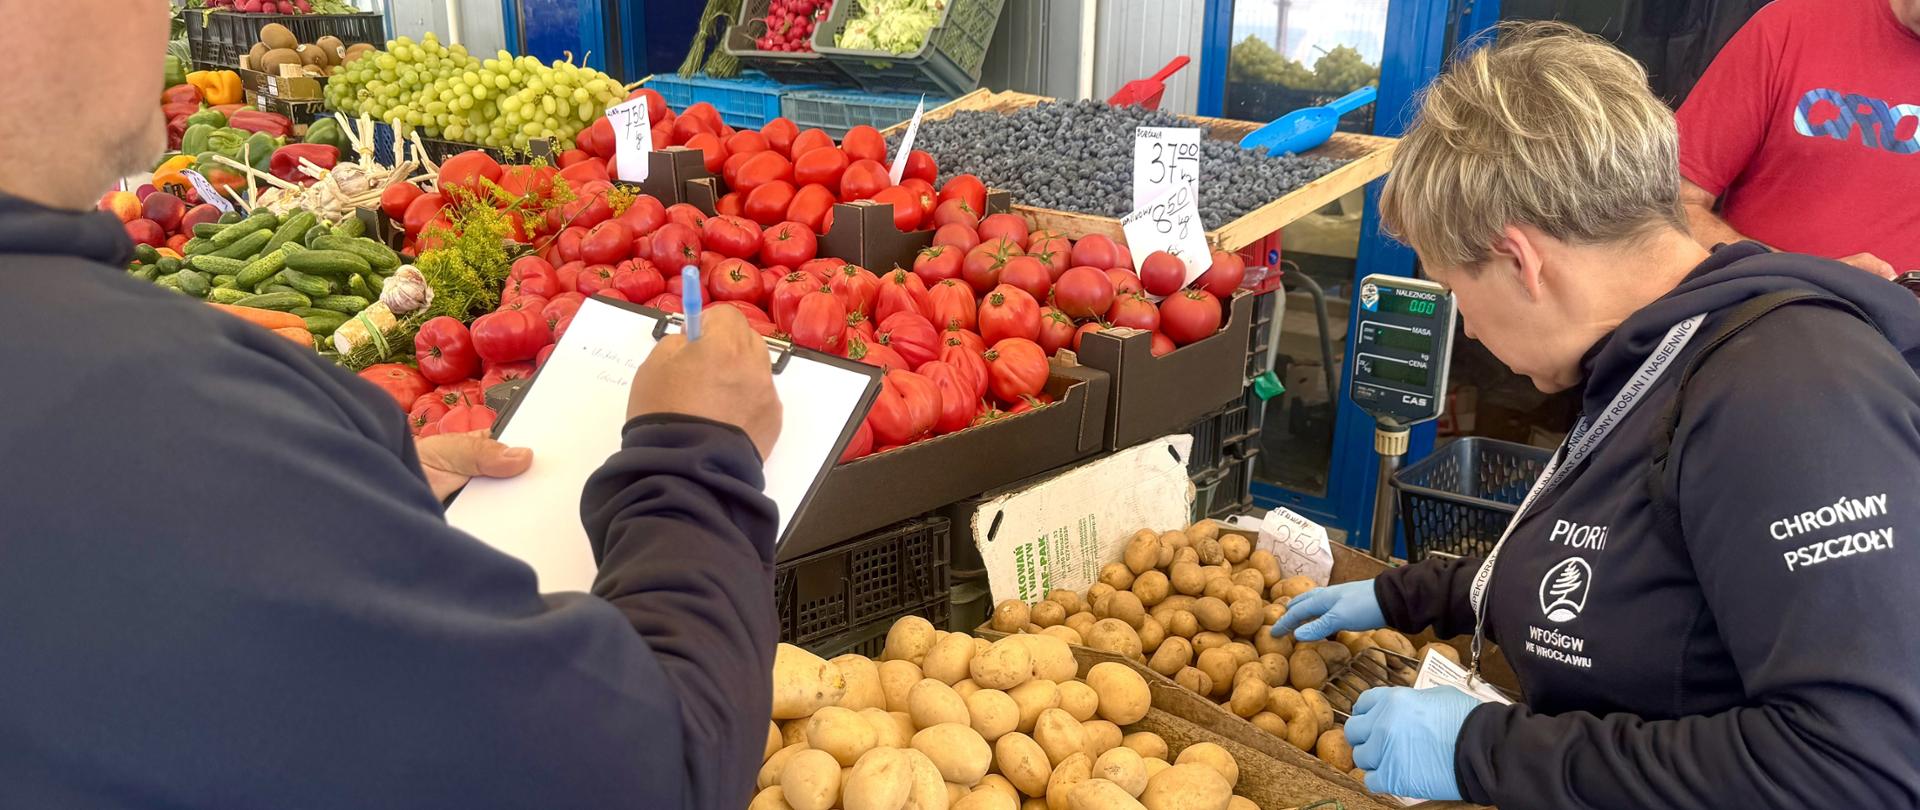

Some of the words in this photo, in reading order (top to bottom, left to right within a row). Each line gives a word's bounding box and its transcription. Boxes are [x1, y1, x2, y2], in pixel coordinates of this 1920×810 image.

[1412, 327, 1432, 337] MASA
[1408, 359, 1428, 369] CENA
[1402, 395, 1427, 406] CAS
[1574, 415, 1614, 460] OCHRONY
[1611, 380, 1645, 416] ROŚLIN
[1550, 519, 1609, 550] PIORi
[1770, 493, 1887, 540] CHROŃMY
[1025, 543, 1036, 592] WARZYW
[1784, 527, 1893, 571] PSZCZOŁY
[1013, 544, 1028, 605] AKOWAŃ
[1536, 645, 1592, 668] WROCŁAWIU
